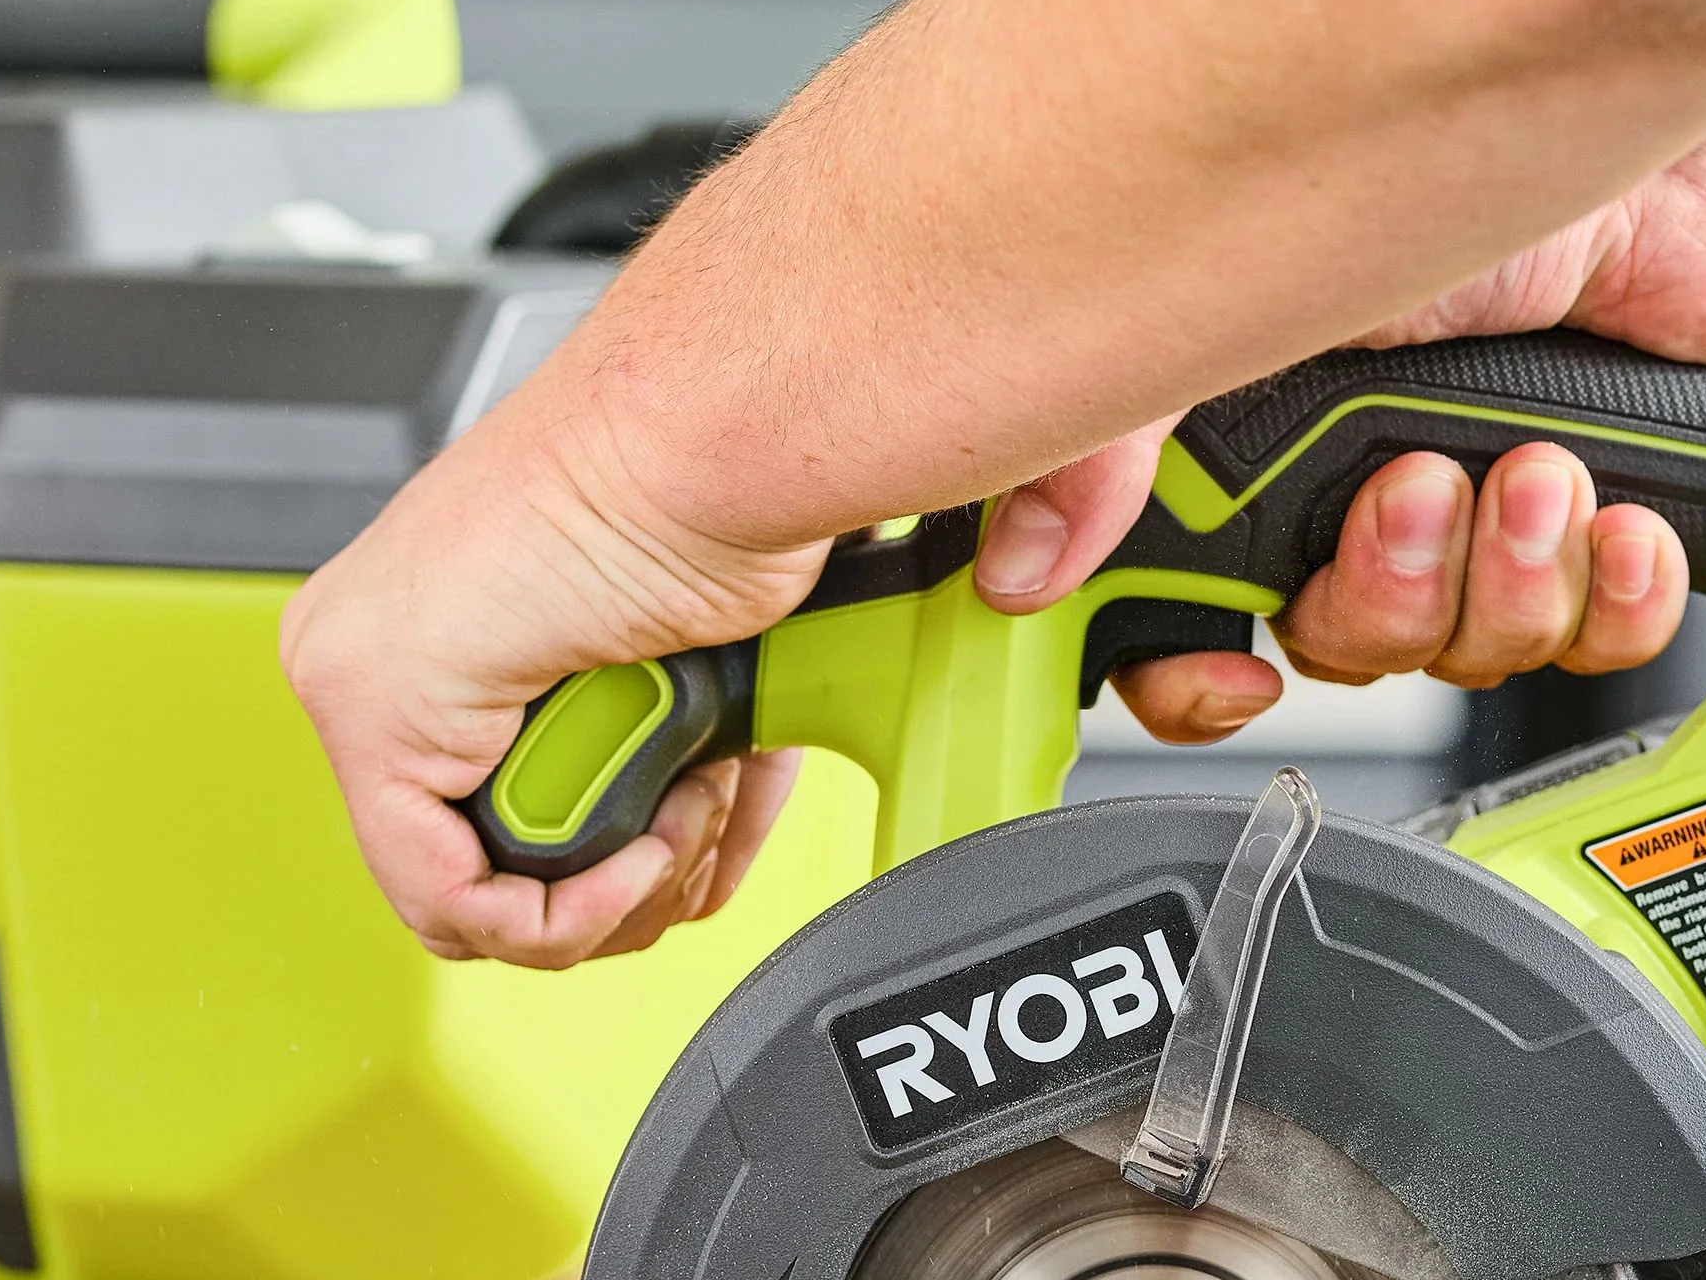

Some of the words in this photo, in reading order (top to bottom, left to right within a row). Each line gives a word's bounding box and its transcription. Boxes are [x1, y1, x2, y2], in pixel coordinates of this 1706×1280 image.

[1634, 879, 1688, 907] Remove
[1658, 916, 1681, 933] the
[1671, 924, 1703, 946] must
[856, 928, 1189, 1119] RYOBI
